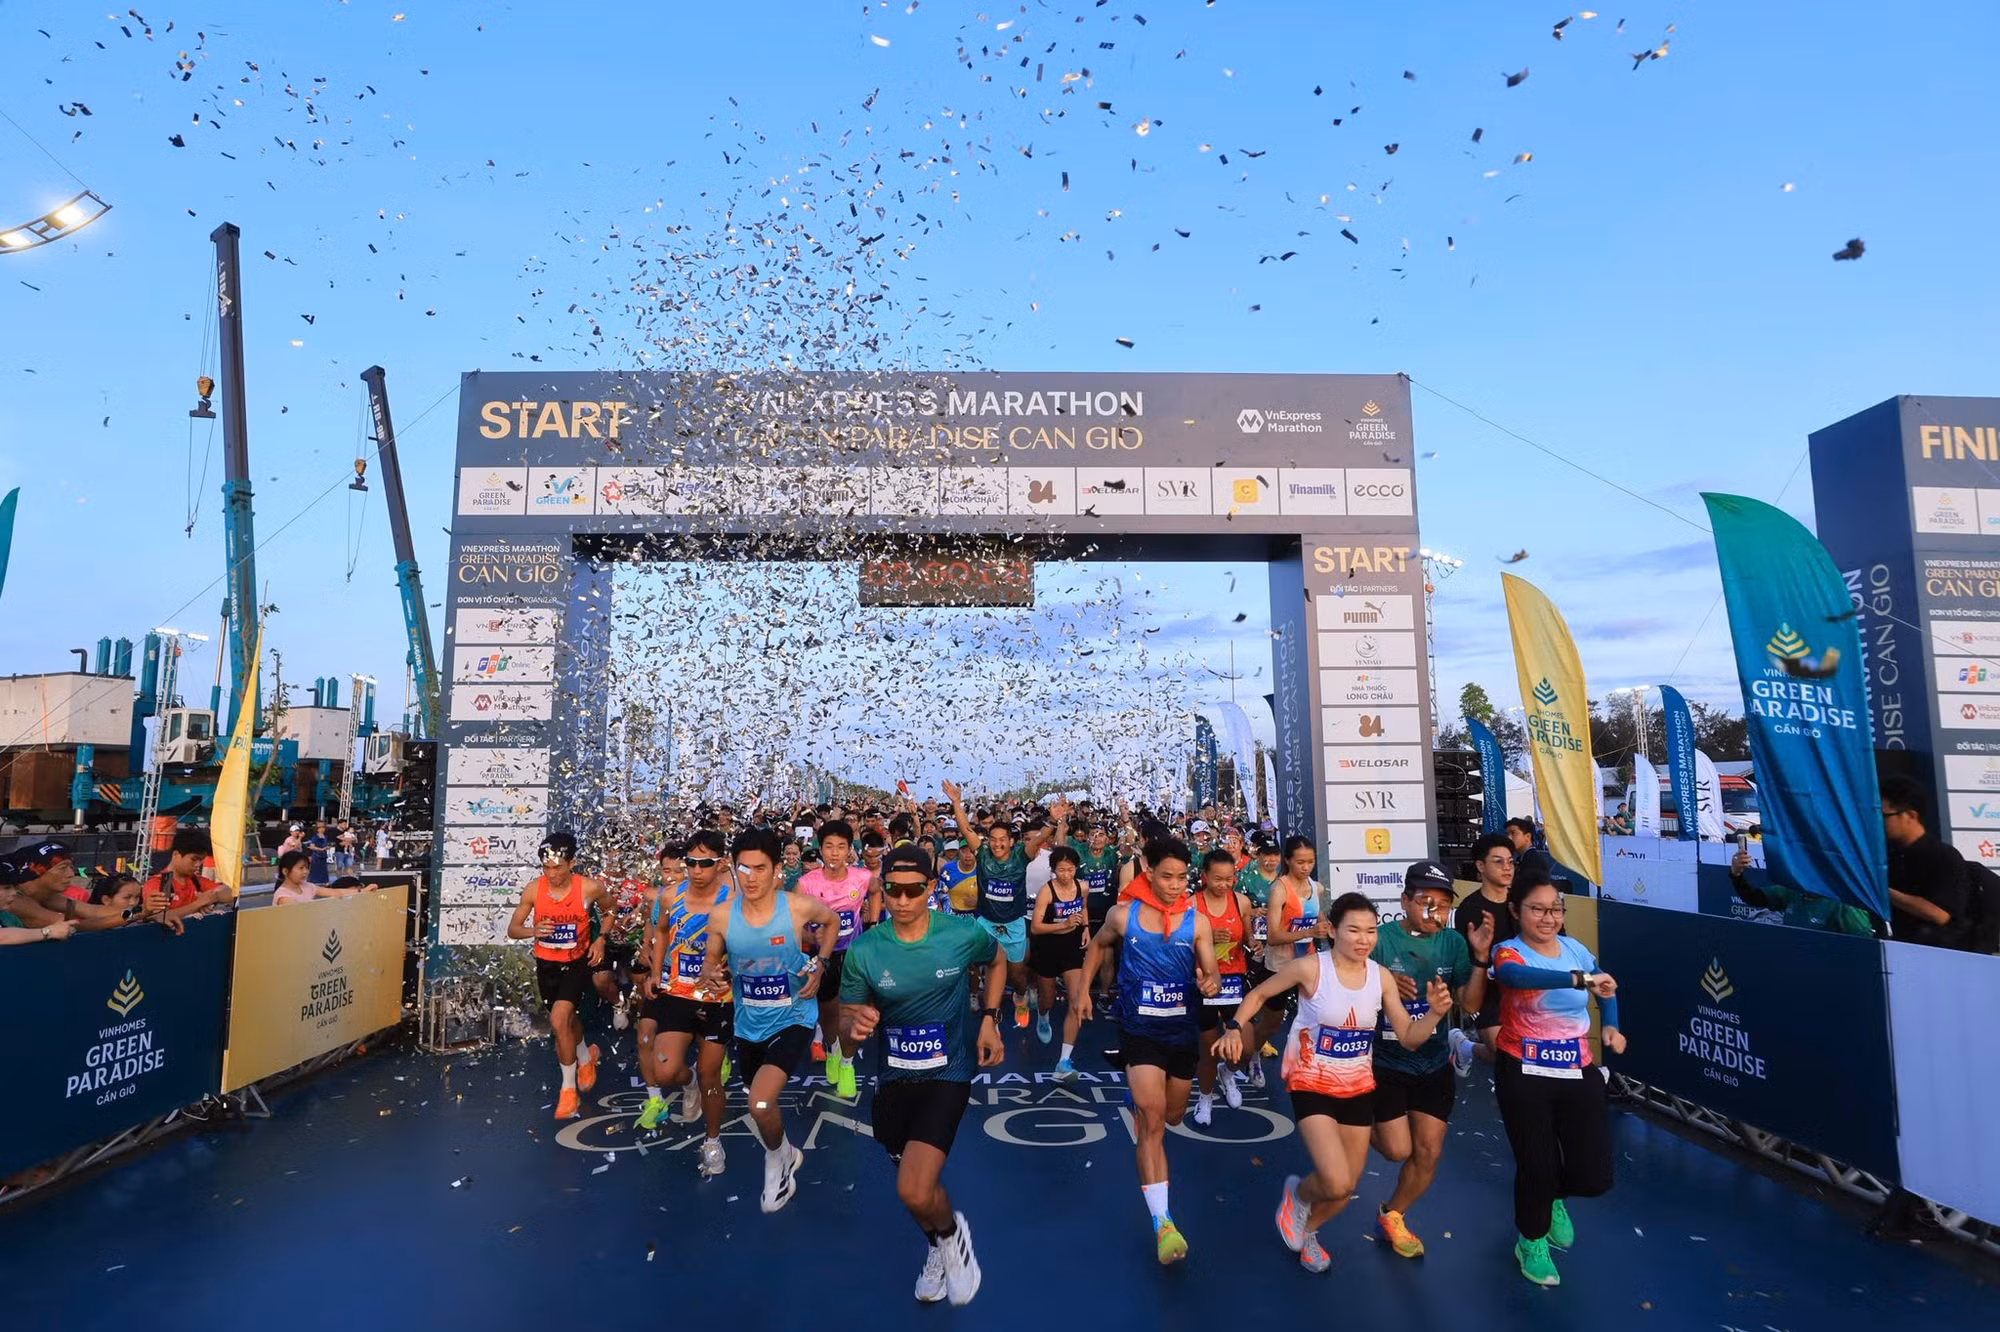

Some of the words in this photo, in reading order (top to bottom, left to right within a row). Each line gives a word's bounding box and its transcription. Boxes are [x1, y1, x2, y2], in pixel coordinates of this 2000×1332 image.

[949, 390, 1143, 416] MARATHON
[479, 400, 630, 440] START
[1265, 410, 1322, 422] VnExpress
[1268, 422, 1322, 433] Marathon
[1349, 431, 1396, 440] PARADISE
[1356, 423, 1388, 431] GREEN
[1009, 426, 1081, 450] CAN
[1085, 426, 1144, 450] GIO
[1920, 426, 2000, 461] FINI
[1028, 480, 1057, 504] 84
[1157, 480, 1198, 498] SVR
[1289, 484, 1336, 495] Vinamilk
[1354, 484, 1404, 497] ecco
[536, 497, 570, 505] GREEN
[460, 554, 499, 564] GREEN
[1314, 546, 1410, 573] START
[1924, 560, 1970, 568] VNEXPRESS
[459, 565, 508, 583] CAN
[1925, 568, 1962, 578] GREEN
[1870, 564, 1892, 616] GIO
[1927, 579, 1974, 597] CAN
[1979, 579, 2000, 598] GI
[1344, 612, 1378, 623] PUMA
[1875, 624, 1898, 686] CAN
[1280, 624, 1293, 770] MARATHON
[1752, 680, 1833, 705] GREEN
[1751, 698, 1857, 729] ARADISE
[1359, 715, 1385, 737] 84
[1674, 710, 1687, 768] MARATHON
[1350, 759, 1409, 767] VELOSAR
[1355, 791, 1396, 809] SVR
[1681, 771, 1694, 832] VNEXPRESS
[1356, 872, 1403, 885] Vinamilk
[549, 931, 574, 940] 1243
[310, 976, 347, 1000] GREEN
[754, 985, 785, 995] 61397
[1154, 992, 1184, 1002] 61298
[301, 990, 354, 1021] PARADISE
[1697, 1004, 1740, 1025] VINHOMES
[99, 1018, 147, 1039] VINHOMES
[1690, 1017, 1750, 1052] GREEN
[86, 1031, 152, 1068] GREEN
[901, 1039, 942, 1053] 60796
[1333, 1040, 1368, 1052] 60333
[1528, 1045, 1535, 1057] F
[1541, 1049, 1577, 1062] 61307
[1679, 1033, 1766, 1080] PARADISE
[65, 1048, 165, 1098] PARADISE
